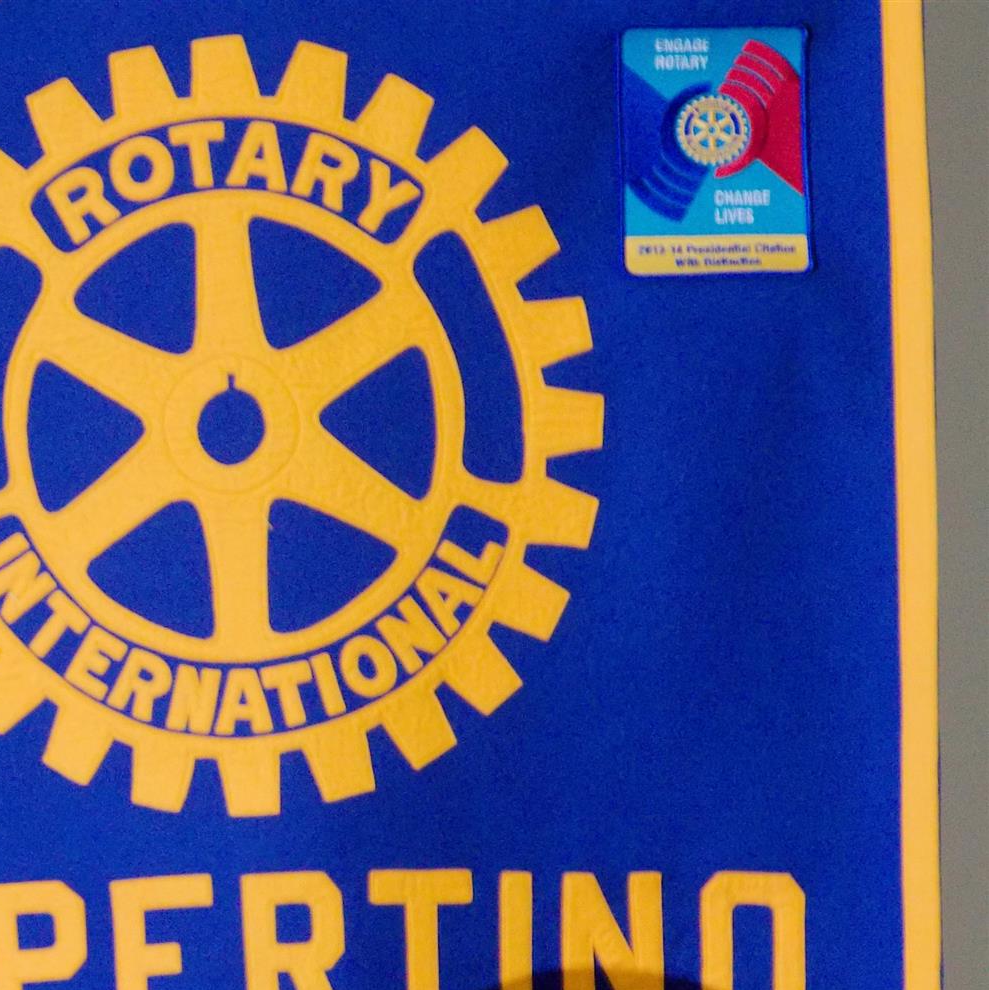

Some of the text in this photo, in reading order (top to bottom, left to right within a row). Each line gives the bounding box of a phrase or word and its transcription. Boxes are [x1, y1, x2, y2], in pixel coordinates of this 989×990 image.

[654, 37, 709, 52] ENGAGE
[654, 54, 709, 70] ROTARY
[47, 119, 420, 241] ROTARY
[714, 189, 771, 206] CHANGE
[714, 208, 754, 225] LIVES
